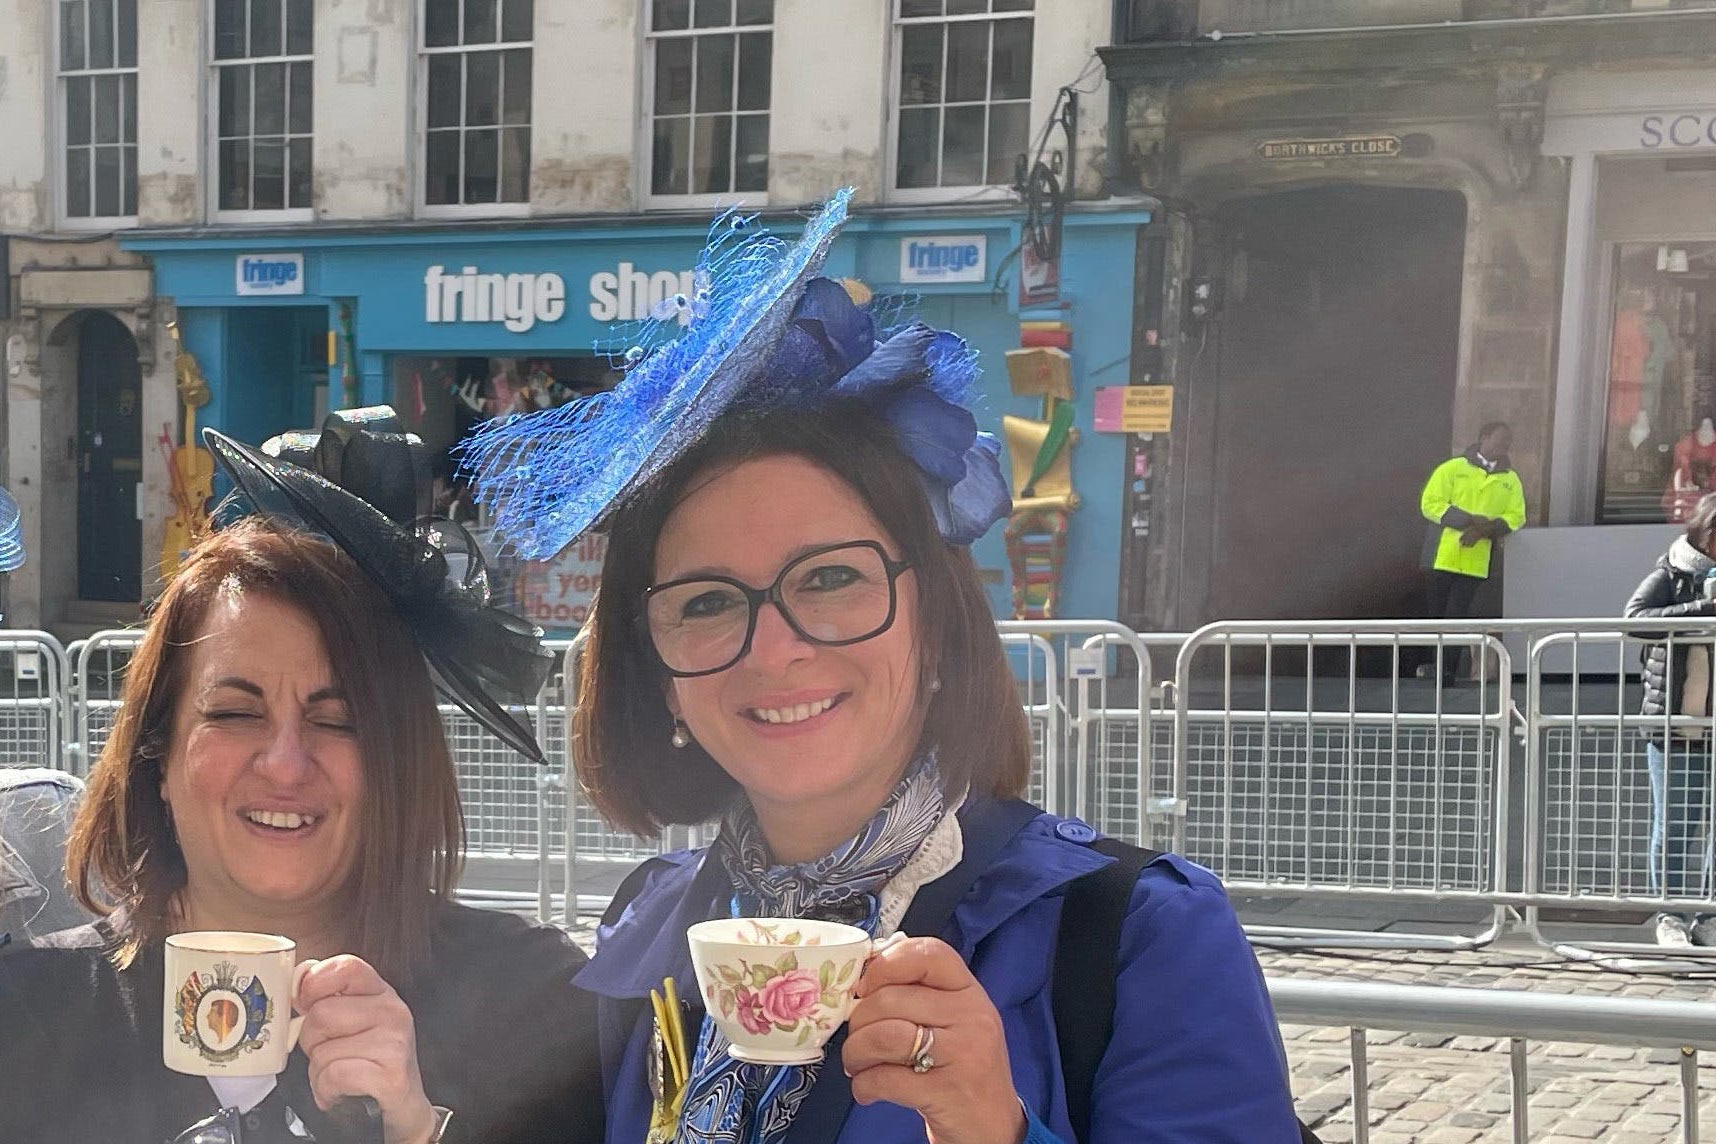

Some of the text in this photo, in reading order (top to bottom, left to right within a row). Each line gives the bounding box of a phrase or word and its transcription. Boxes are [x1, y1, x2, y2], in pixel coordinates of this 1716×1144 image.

[1350, 139, 1395, 153] CLOSE
[908, 241, 979, 272] fringe
[243, 258, 297, 286] fringe
[425, 265, 566, 333] fringe
